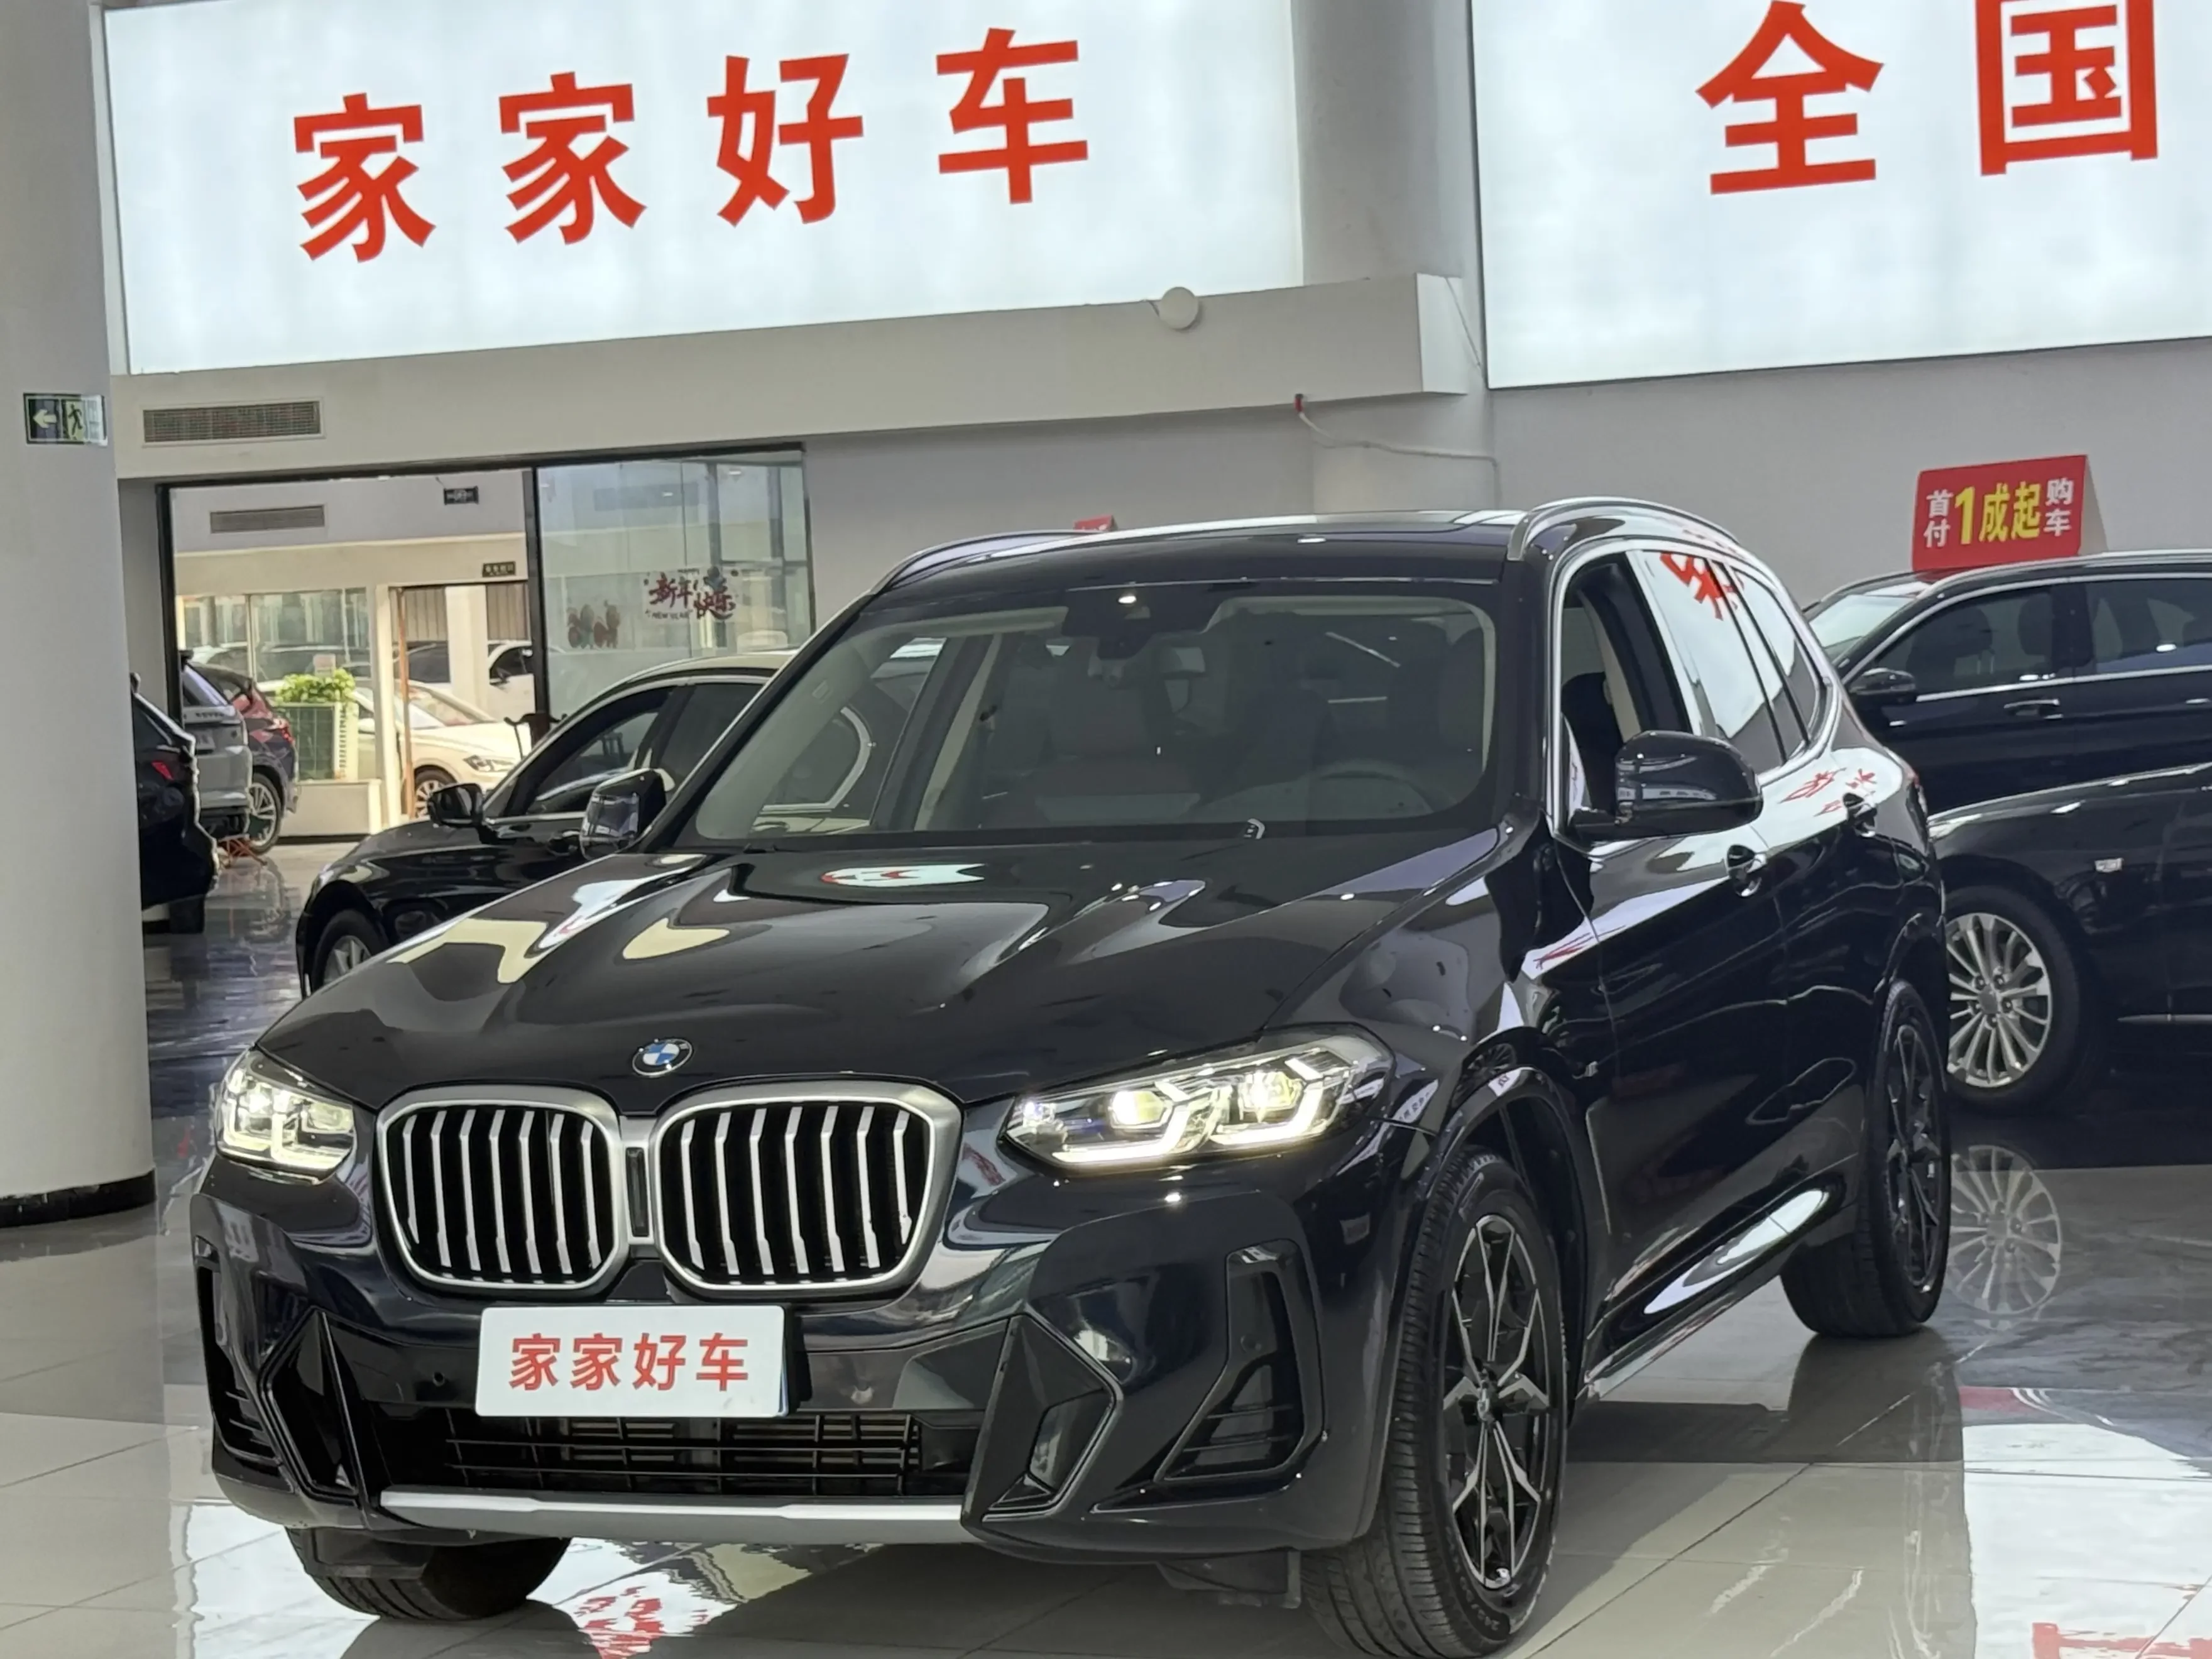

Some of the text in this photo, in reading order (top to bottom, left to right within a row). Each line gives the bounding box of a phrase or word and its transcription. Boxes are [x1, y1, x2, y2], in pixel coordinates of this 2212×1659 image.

[293, 27, 1089, 263] 家家好车
[1695, 0, 2159, 195] 全国
[1924, 476, 2074, 549] 首付 1成起 购车
[509, 1332, 748, 1391] 家家好车
